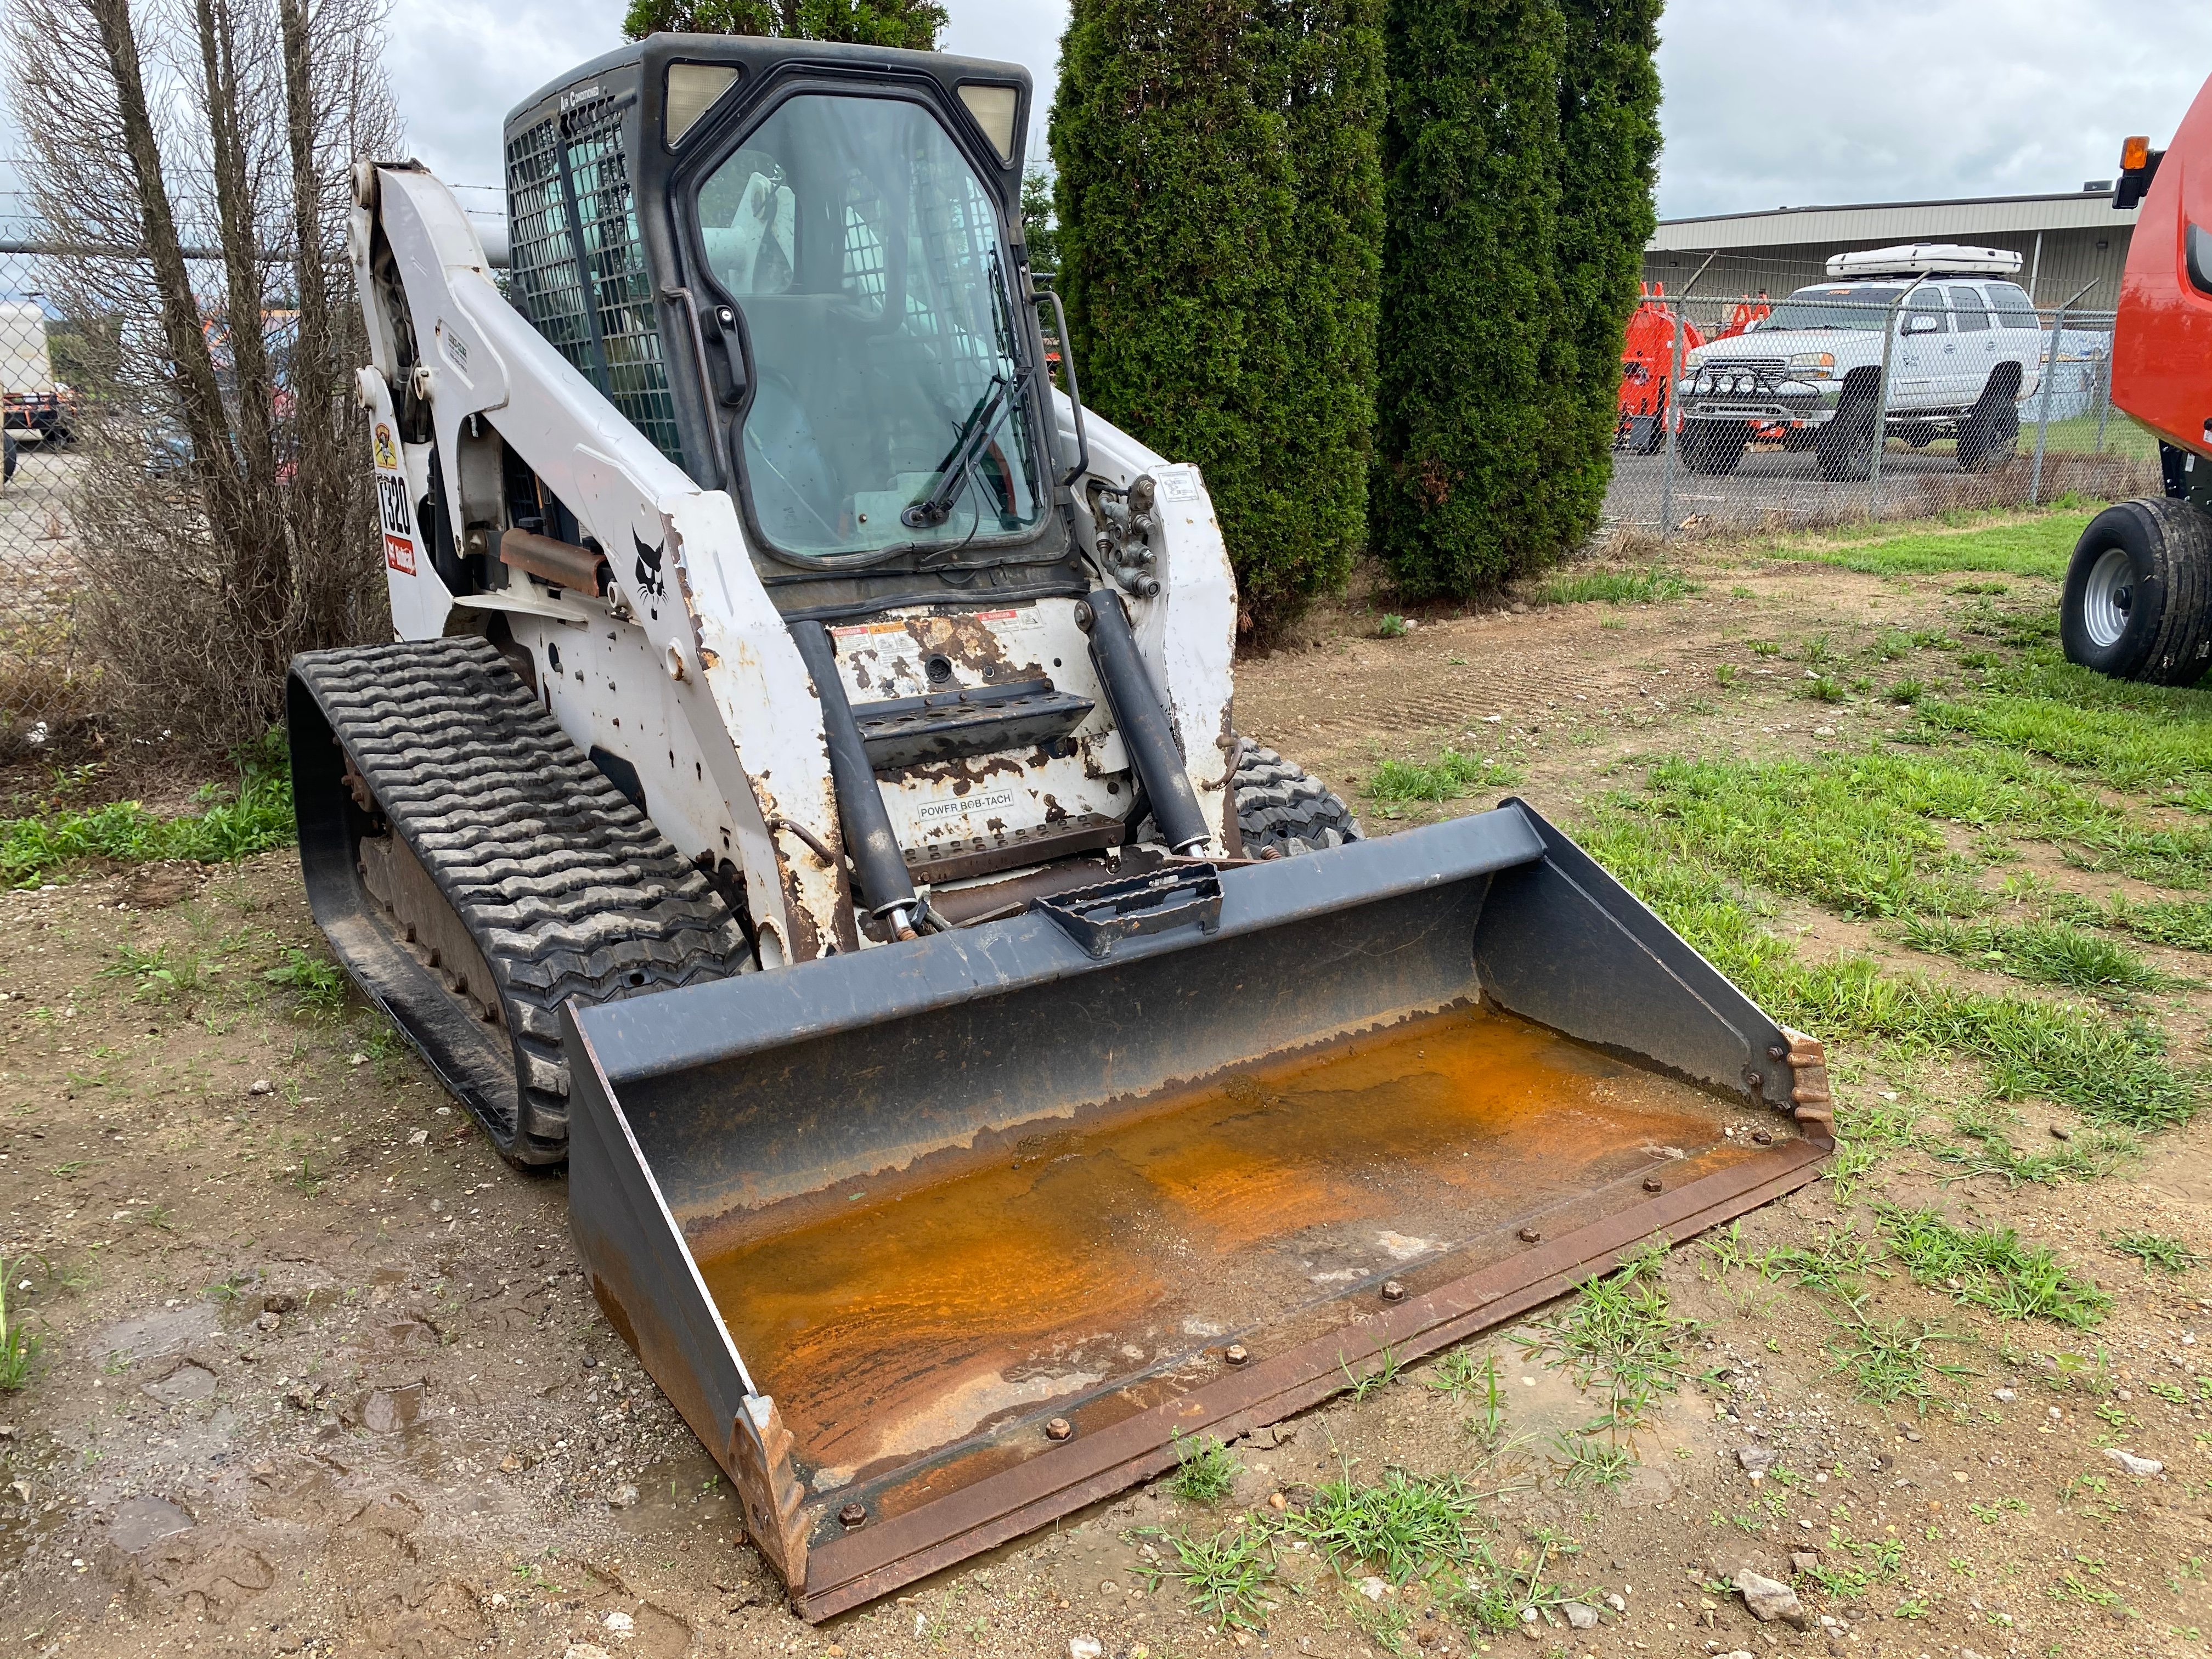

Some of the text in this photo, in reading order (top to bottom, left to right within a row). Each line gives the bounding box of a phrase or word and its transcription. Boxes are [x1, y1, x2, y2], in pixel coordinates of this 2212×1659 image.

[377, 475, 410, 535] T320
[835, 628, 861, 636] DANGER
[960, 794, 1011, 811] BOB-TACH
